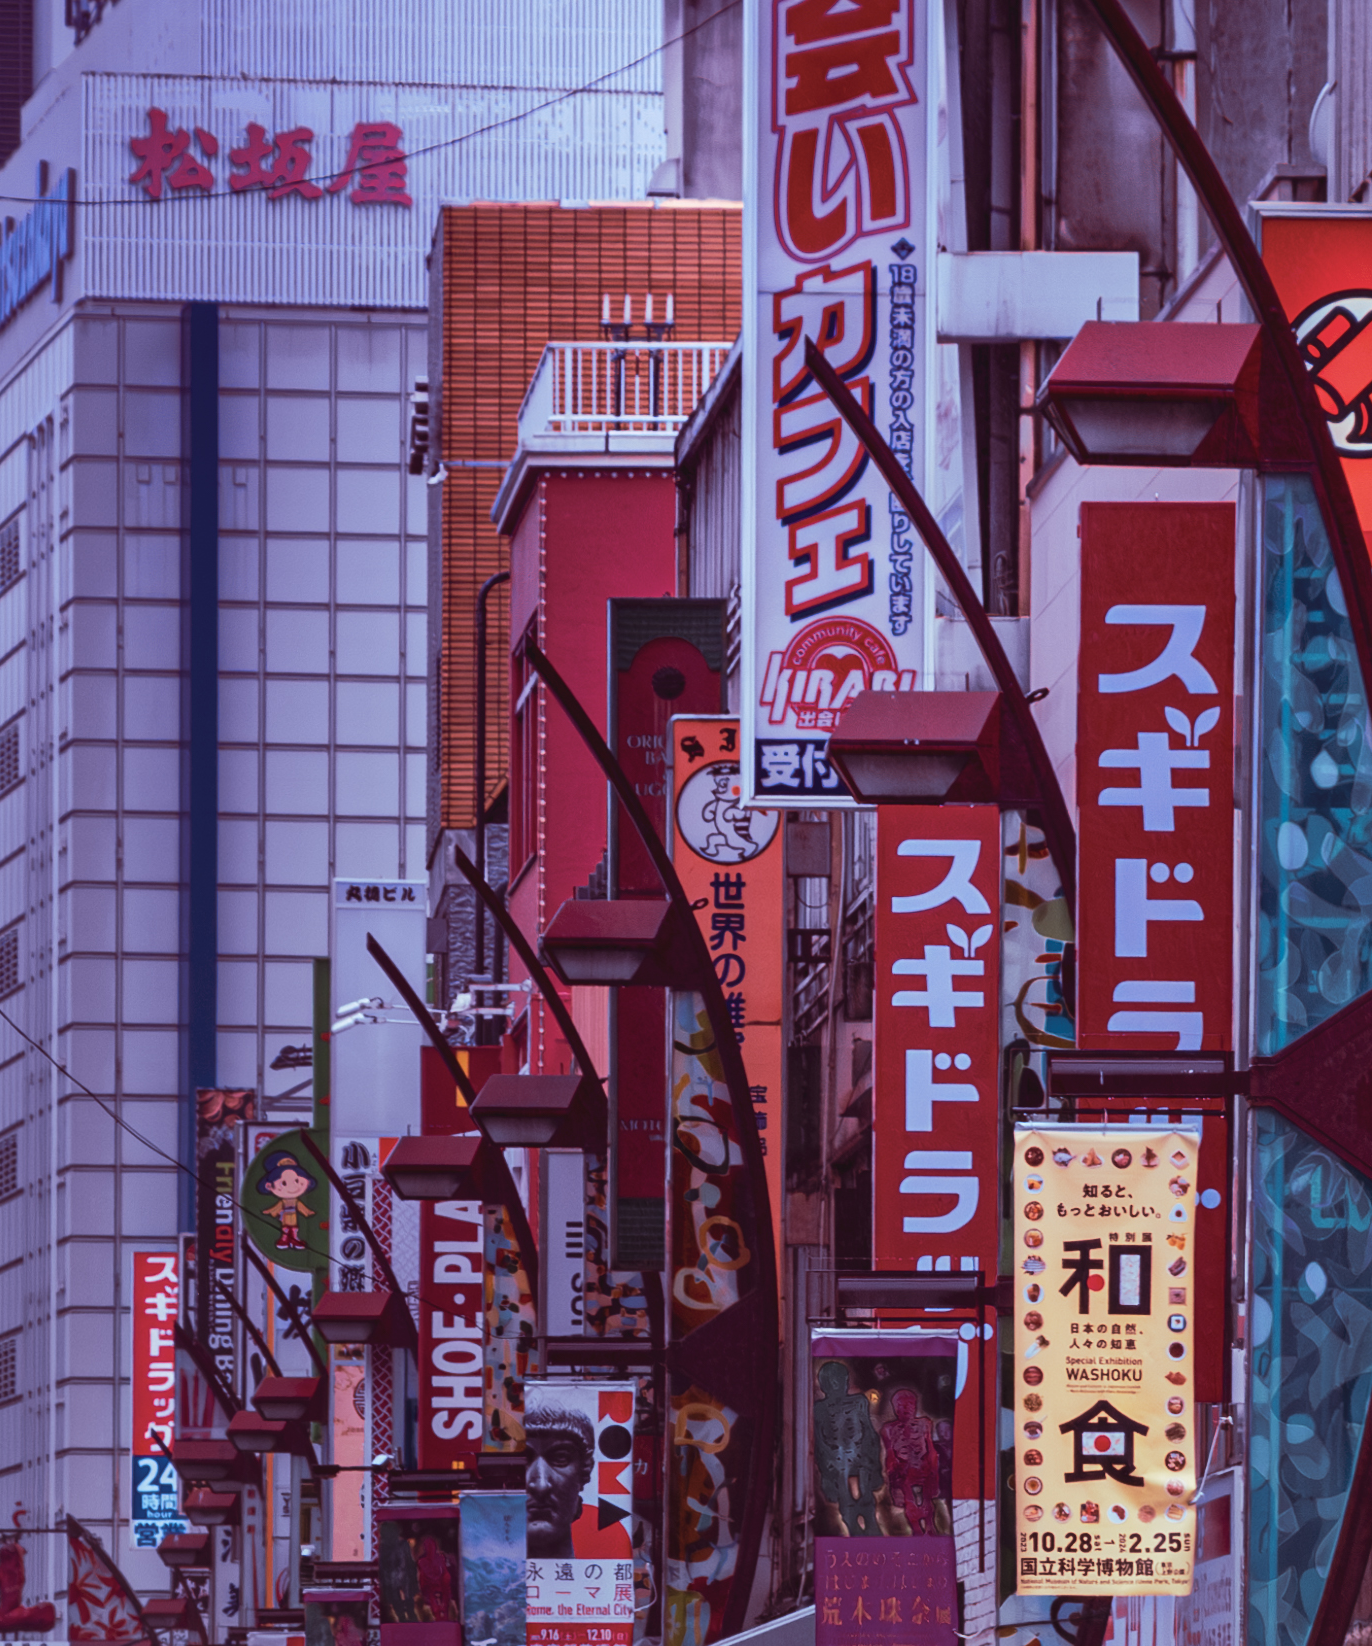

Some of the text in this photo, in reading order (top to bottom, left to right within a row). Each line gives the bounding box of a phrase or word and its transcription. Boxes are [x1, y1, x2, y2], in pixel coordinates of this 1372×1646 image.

[131, 107, 413, 206] 松坂屋
[1082, 1184, 1133, 1199] 知ると、
[1057, 1202, 1162, 1219] もっとおいしい。
[1108, 1232, 1153, 1243] 特別展
[1058, 1238, 1152, 1316] 和
[1070, 1323, 1144, 1335] 日本の自然、
[1069, 1339, 1137, 1350] 人々の知恵
[1065, 1356, 1143, 1367] Special Exhibition
[1066, 1368, 1143, 1382] WASHOKU
[1059, 1400, 1149, 1488] 食
[141, 1494, 178, 1511] 時間
[147, 1511, 174, 1520] hour
[1029, 1531, 1092, 1553] 10.28
[1129, 1531, 1181, 1553] 2.25
[526, 1562, 633, 1581] 永遠の都
[1020, 1557, 1154, 1577] 国立科学博物館
[526, 1584, 634, 1602] ローマ展
[557, 1603, 573, 1616] the
[576, 1603, 611, 1616] Eternal
